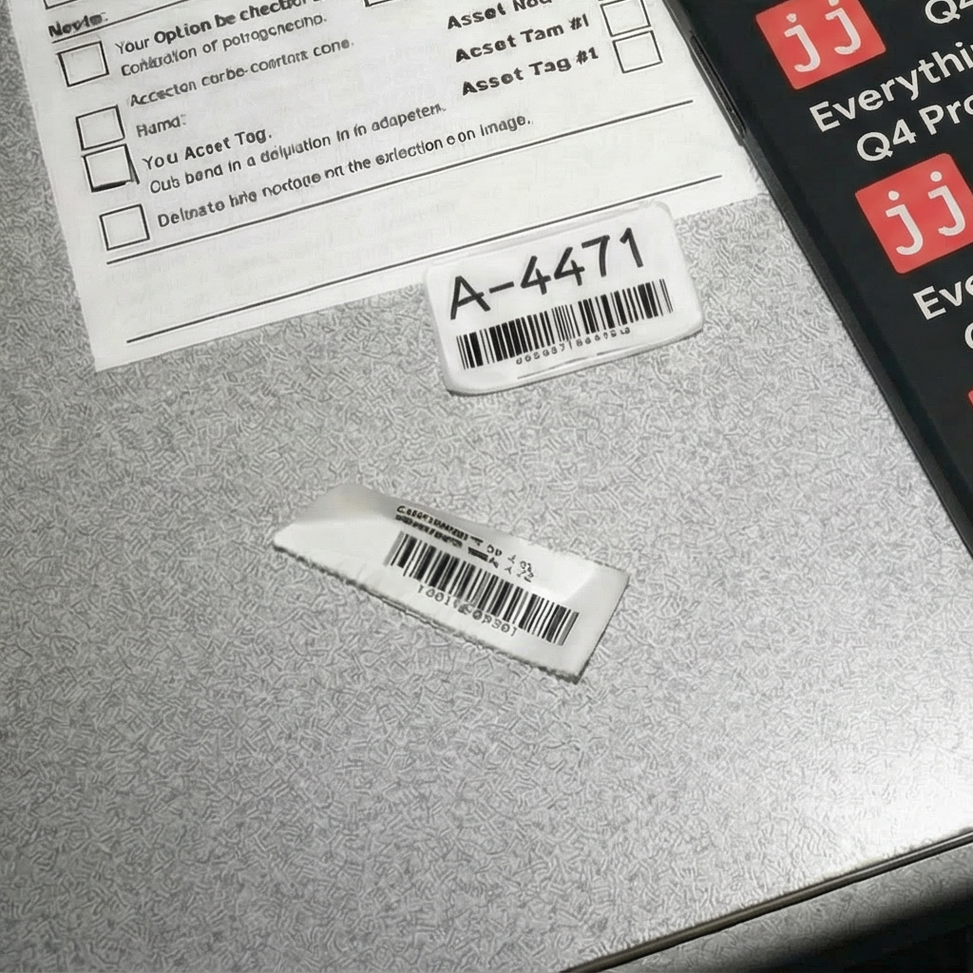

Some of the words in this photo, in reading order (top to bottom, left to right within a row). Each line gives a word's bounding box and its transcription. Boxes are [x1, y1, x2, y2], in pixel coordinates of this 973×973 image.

[115, 37, 151, 55] Your
[153, 18, 212, 47] Option
[214, 8, 237, 28] be
[520, 24, 564, 44] Tam
[528, 57, 572, 76] Tag
[575, 46, 599, 65] #1
[856, 119, 917, 163] Q4
[142, 151, 179, 170] You
[348, 158, 371, 173] the
[450, 227, 644, 321] A-4471
